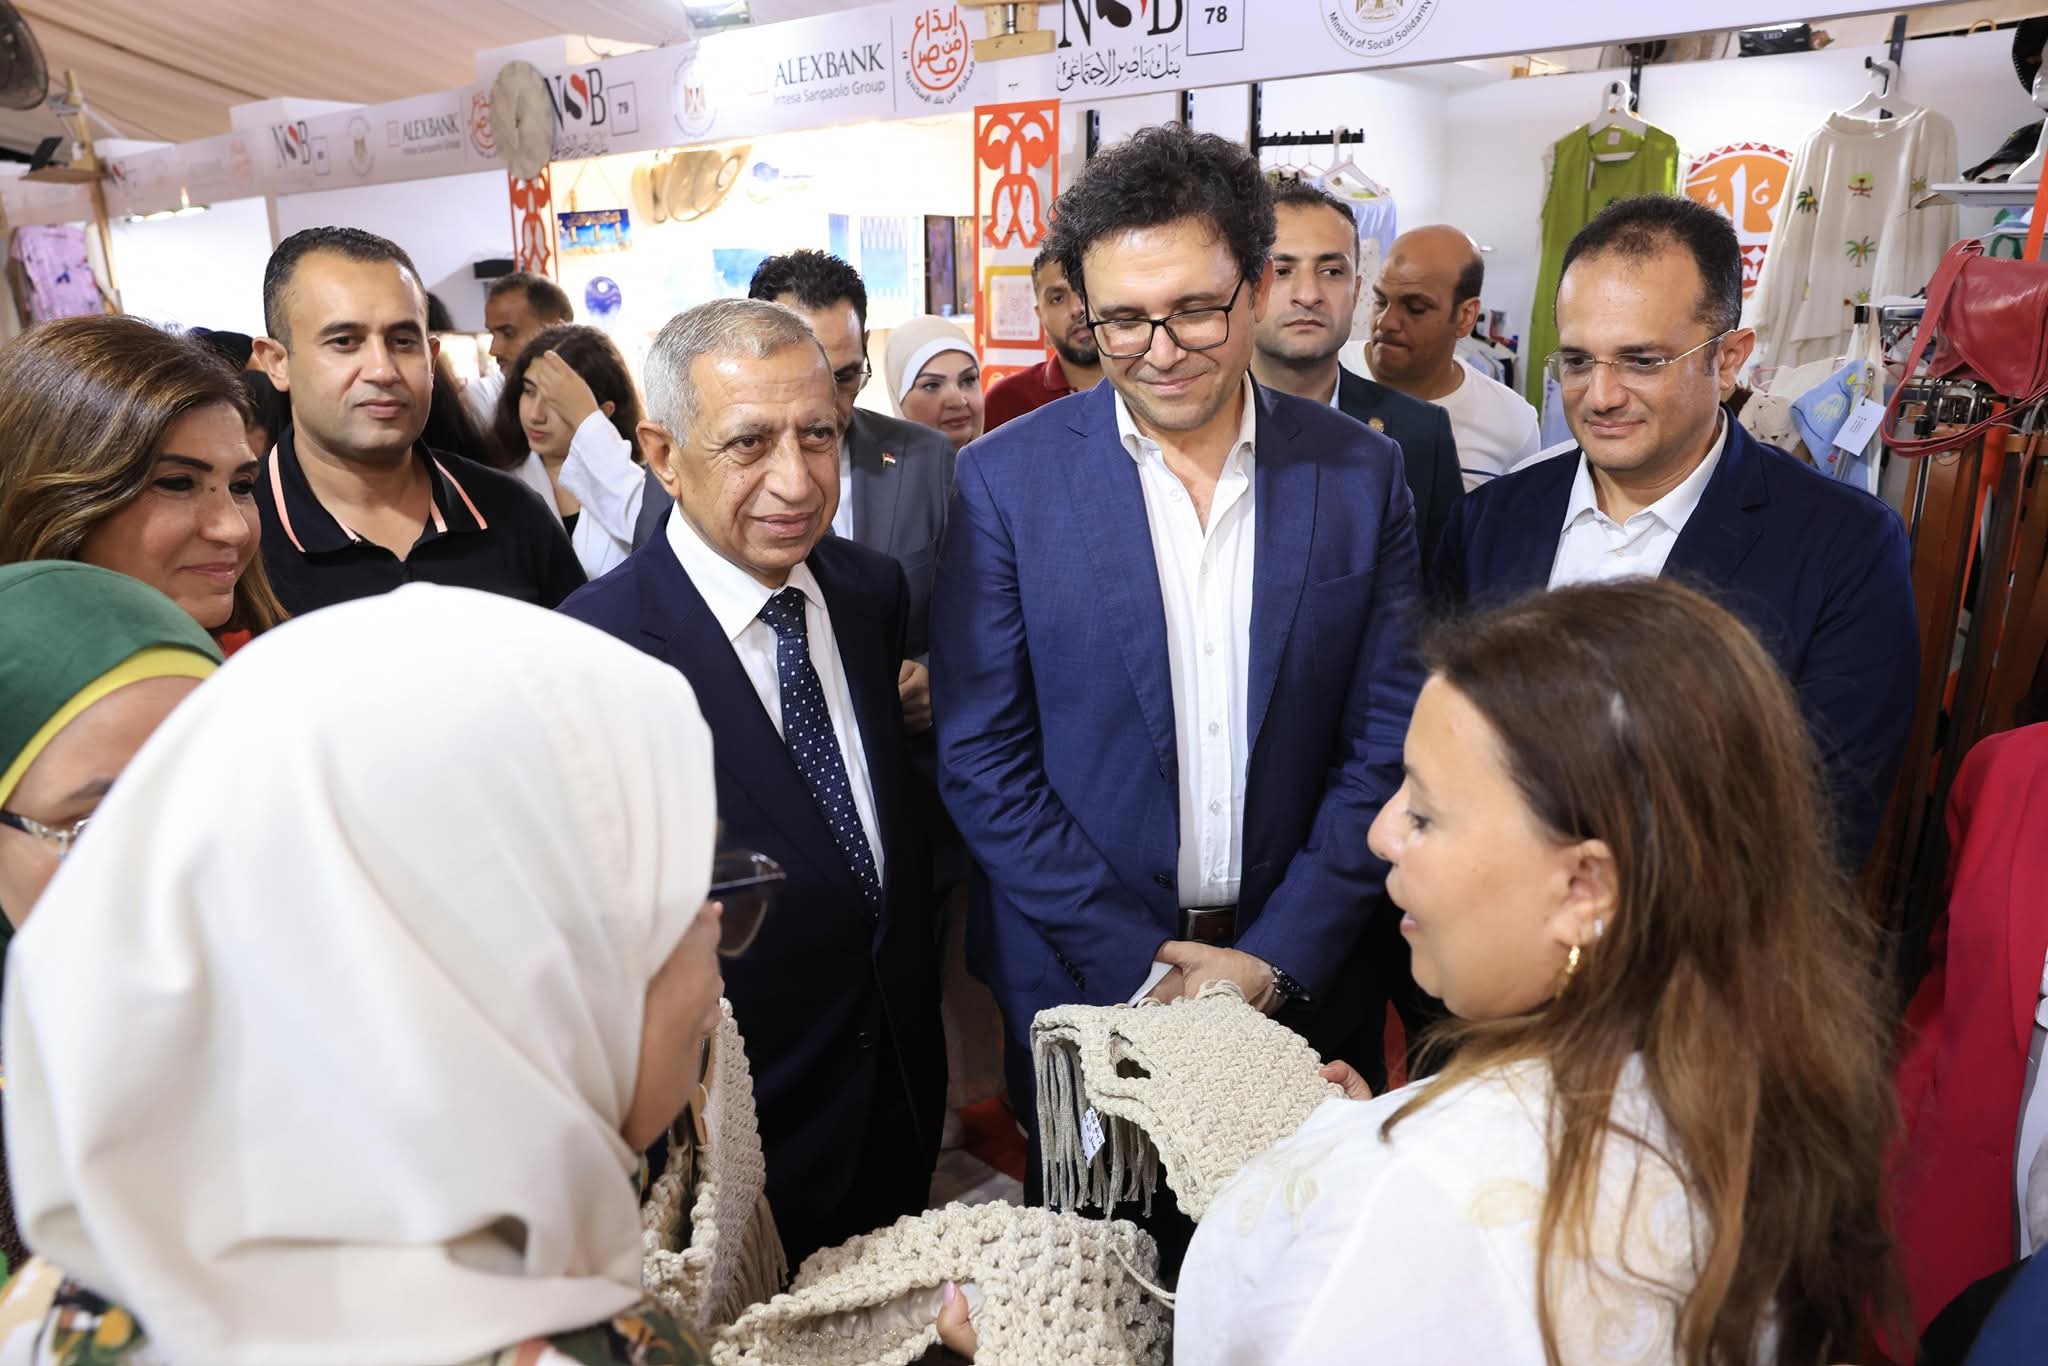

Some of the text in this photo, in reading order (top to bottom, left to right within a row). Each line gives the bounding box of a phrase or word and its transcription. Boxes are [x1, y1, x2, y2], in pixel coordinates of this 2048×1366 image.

[1205, 6, 1227, 24] 78
[1328, 0, 1432, 50] Ministry of Social Solidarity
[774, 43, 884, 87] ALEXBANK
[803, 85, 850, 104] Sanpaolo
[851, 79, 886, 98] Group
[403, 112, 460, 141] ALEXBANK
